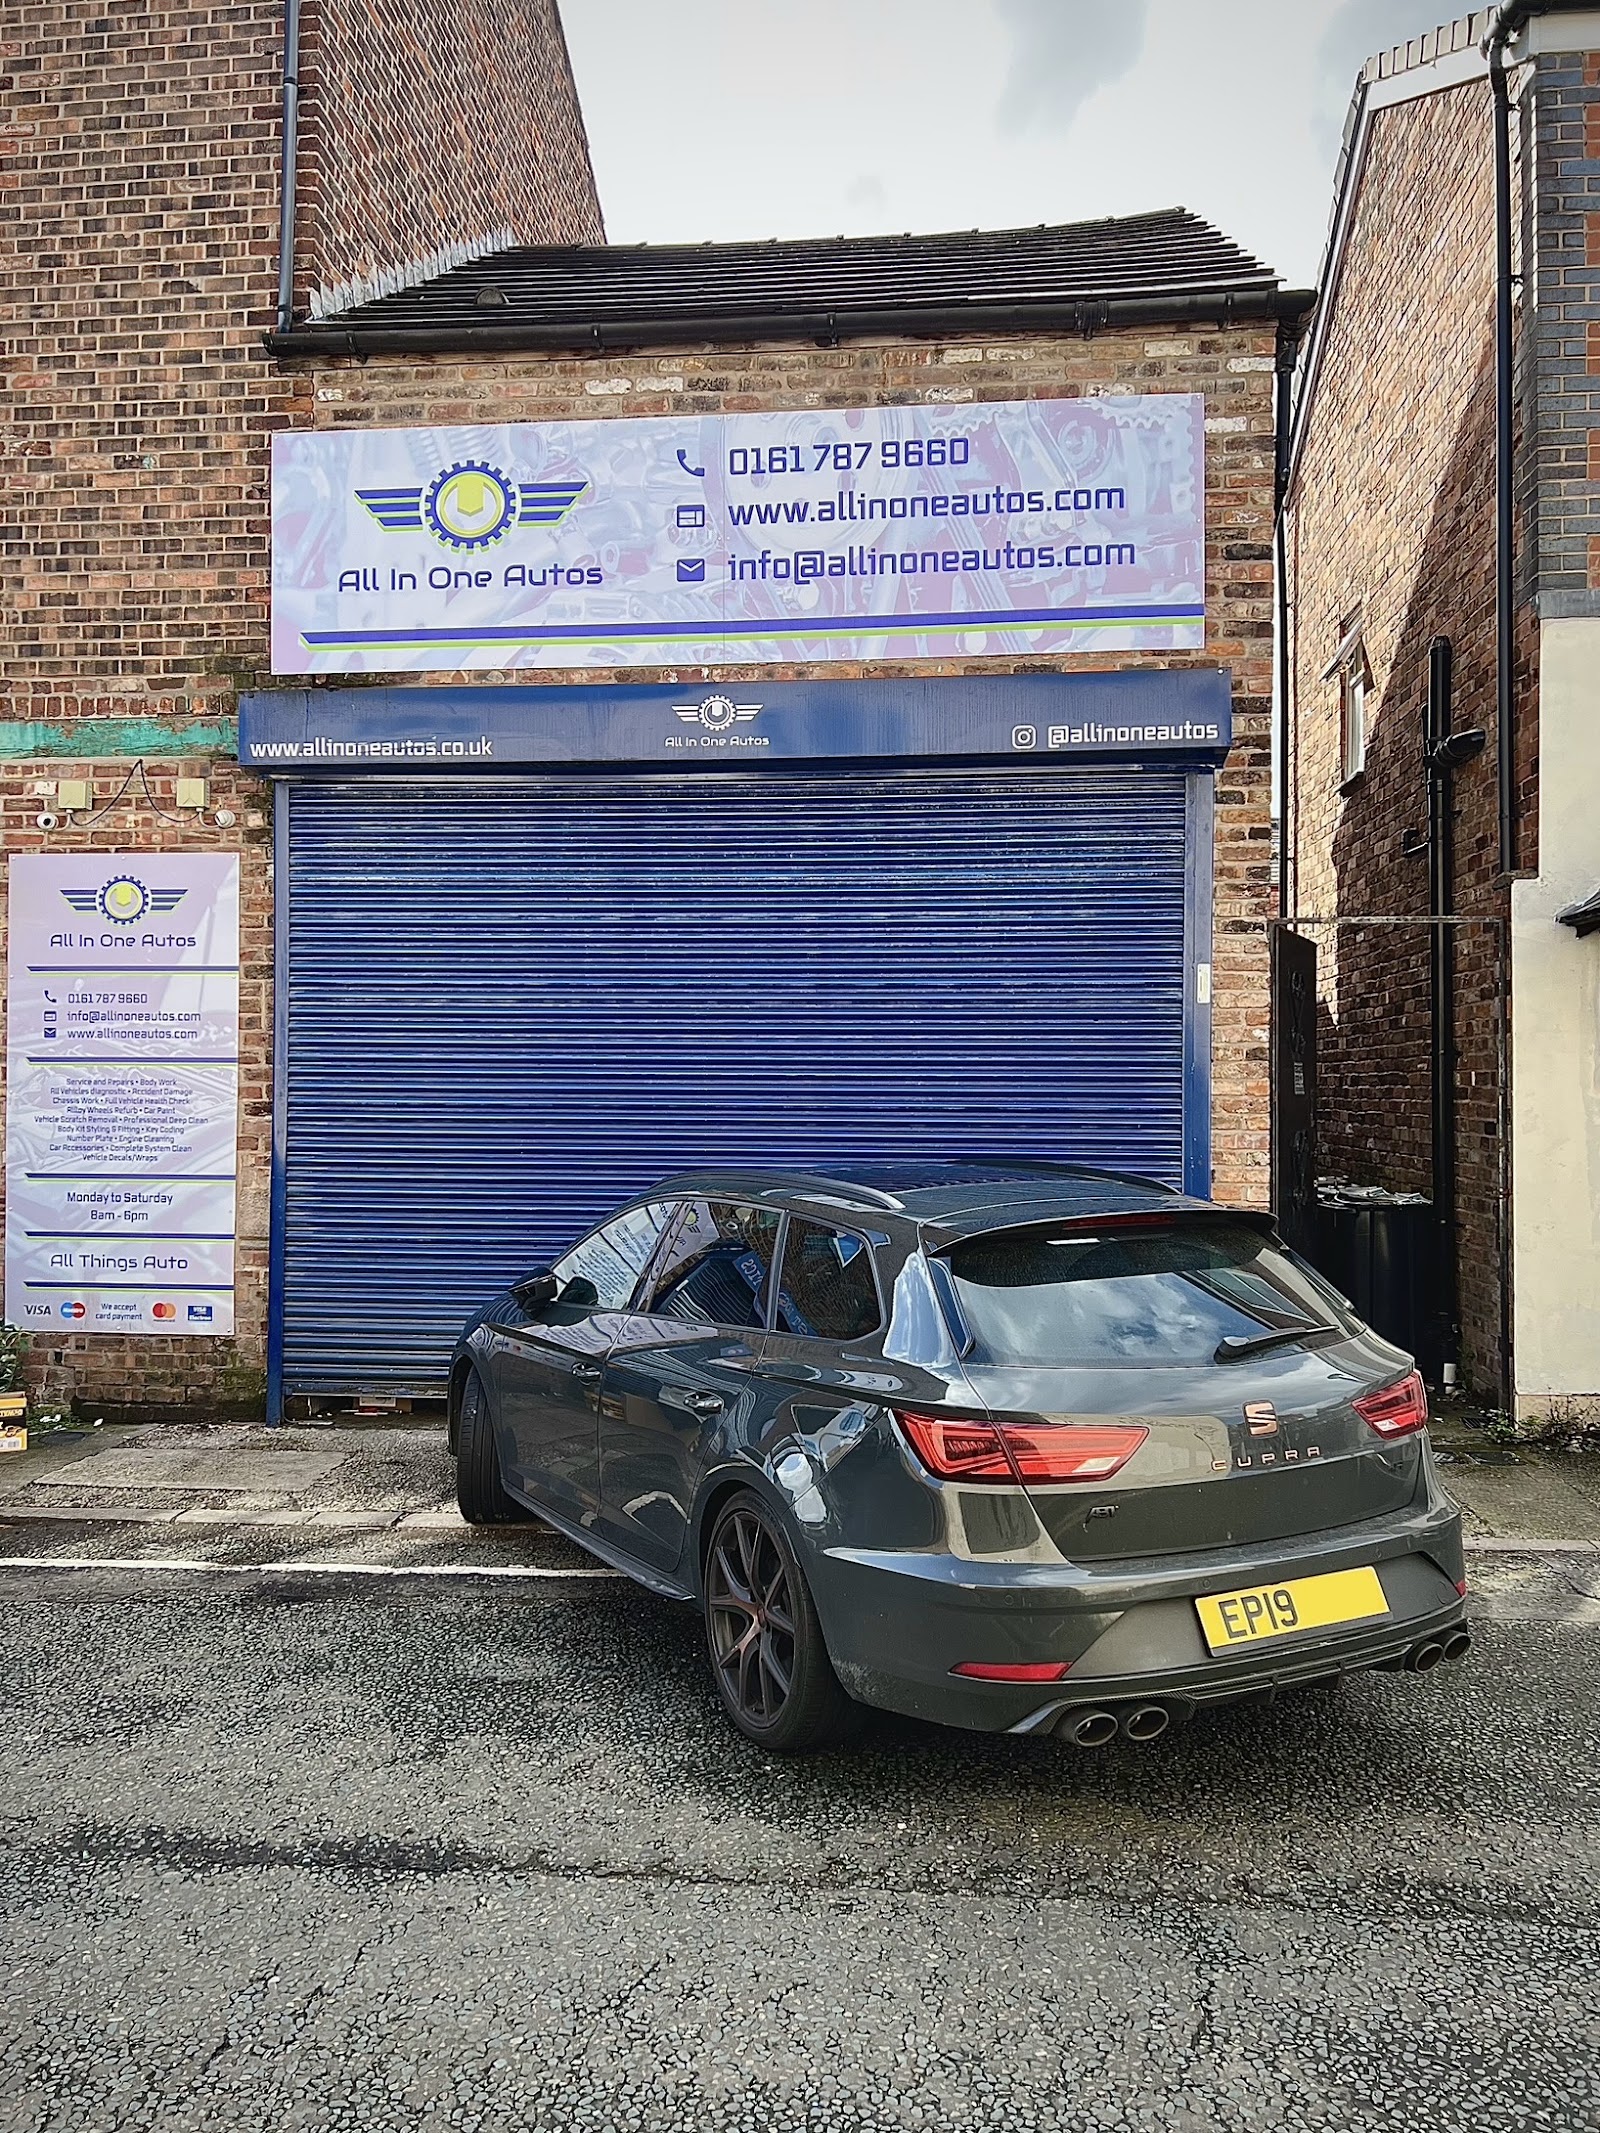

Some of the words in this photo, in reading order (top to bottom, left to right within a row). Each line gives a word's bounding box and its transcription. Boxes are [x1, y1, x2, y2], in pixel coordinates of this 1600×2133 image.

[729, 446, 805, 477] 0161
[811, 441, 873, 474] 787
[880, 437, 970, 469] 9660
[729, 486, 1124, 526] www.allinoneautos.com
[728, 542, 1135, 585] info@allinoneautos.com
[338, 567, 380, 593] All
[390, 567, 418, 592] In
[429, 566, 492, 589] One
[502, 562, 604, 588] Autos
[1048, 720, 1219, 749] @allinoneautos
[250, 736, 493, 757] www.allinoneautos.co.uk
[664, 736, 683, 748] All
[685, 736, 697, 747] In
[700, 736, 727, 747] One
[730, 735, 769, 747] Autos
[50, 934, 73, 947] All
[79, 934, 94, 947] In
[100, 934, 136, 947] One
[142, 934, 196, 947] Autos
[68, 993, 93, 1003] 0161
[96, 993, 116, 1003] 787
[118, 993, 147, 1003] 9660
[67, 1010, 201, 1023] info@allinoneautos.com
[67, 1028, 197, 1039] www.allinoneautos.com
[93, 1078, 106, 1086] and
[108, 1078, 134, 1087] Repairs
[140, 1079, 157, 1087] Body
[90, 1088, 126, 1097] diagnostic
[164, 1088, 193, 1097] Damage
[169, 1097, 190, 1105] Check
[169, 1117, 187, 1125] Deep
[58, 1126, 74, 1134] Body
[86, 1126, 110, 1134] Styling
[118, 1126, 140, 1135] Fitting
[146, 1126, 159, 1135] Key
[160, 1126, 184, 1135] Coding
[119, 1135, 142, 1144] Engine
[110, 1145, 143, 1154] Complete
[145, 1145, 171, 1154] System
[109, 1154, 158, 1163] Decals/Wraps
[67, 1192, 109, 1205] Monday
[111, 1192, 121, 1203] to
[124, 1193, 173, 1205] Saturday
[90, 1210, 115, 1220] 8am
[124, 1211, 148, 1222] 6pm
[50, 1255, 73, 1267] All
[79, 1255, 138, 1271] Things
[143, 1256, 188, 1269] Auto
[23, 1304, 52, 1315] VISA
[113, 1303, 137, 1312] accept
[112, 1313, 142, 1322] payment
[1212, 1446, 1321, 1471] CUPRA
[1218, 1589, 1299, 1640] EP19
